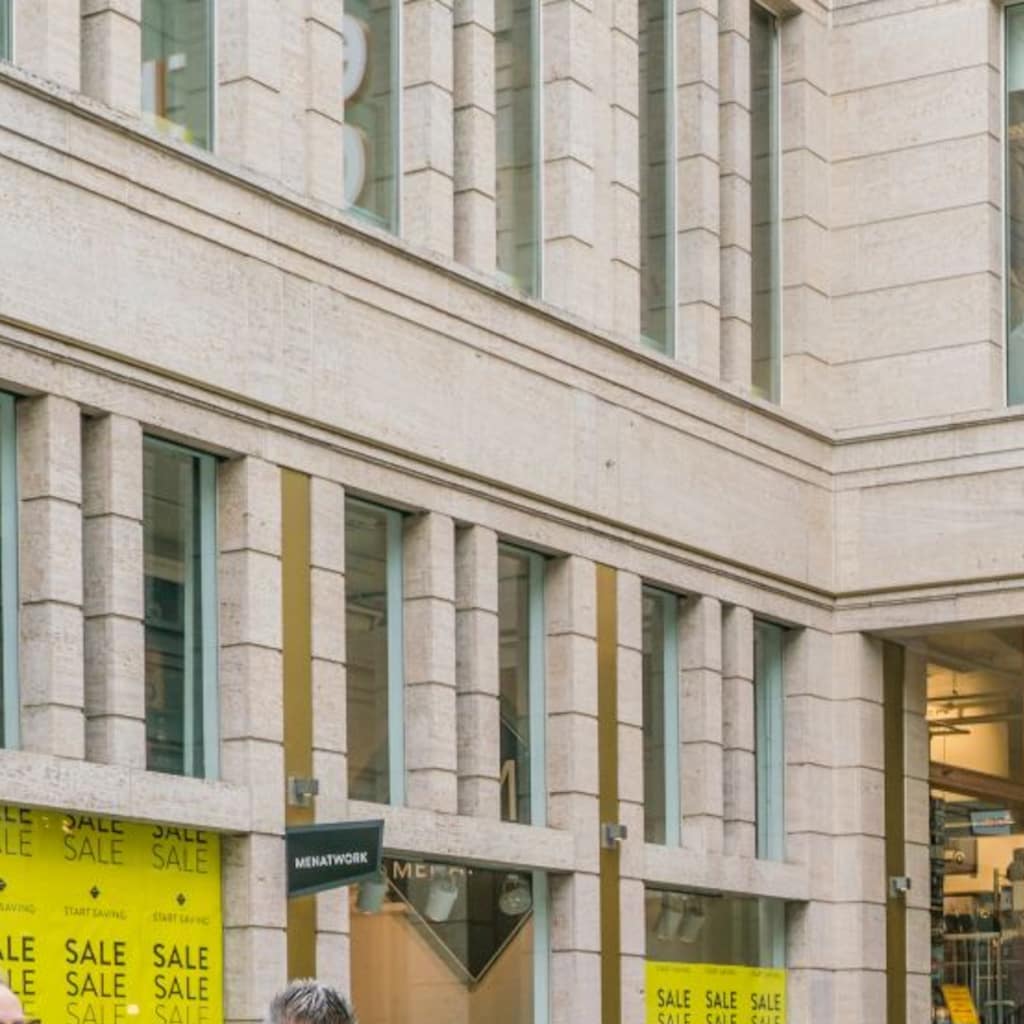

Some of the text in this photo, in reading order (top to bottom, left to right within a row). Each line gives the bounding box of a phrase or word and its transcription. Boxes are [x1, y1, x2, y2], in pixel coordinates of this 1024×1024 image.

[64, 834, 124, 866] SALE
[151, 843, 209, 875] SALE
[295, 851, 368, 869] MENATWORK
[65, 938, 127, 967] SALE
[152, 943, 209, 971] SALE
[66, 970, 127, 999] SALE
[154, 973, 209, 1001] SALE
[657, 988, 692, 1009] SALE
[705, 990, 737, 1009] SALE
[751, 993, 781, 1011] SALE
